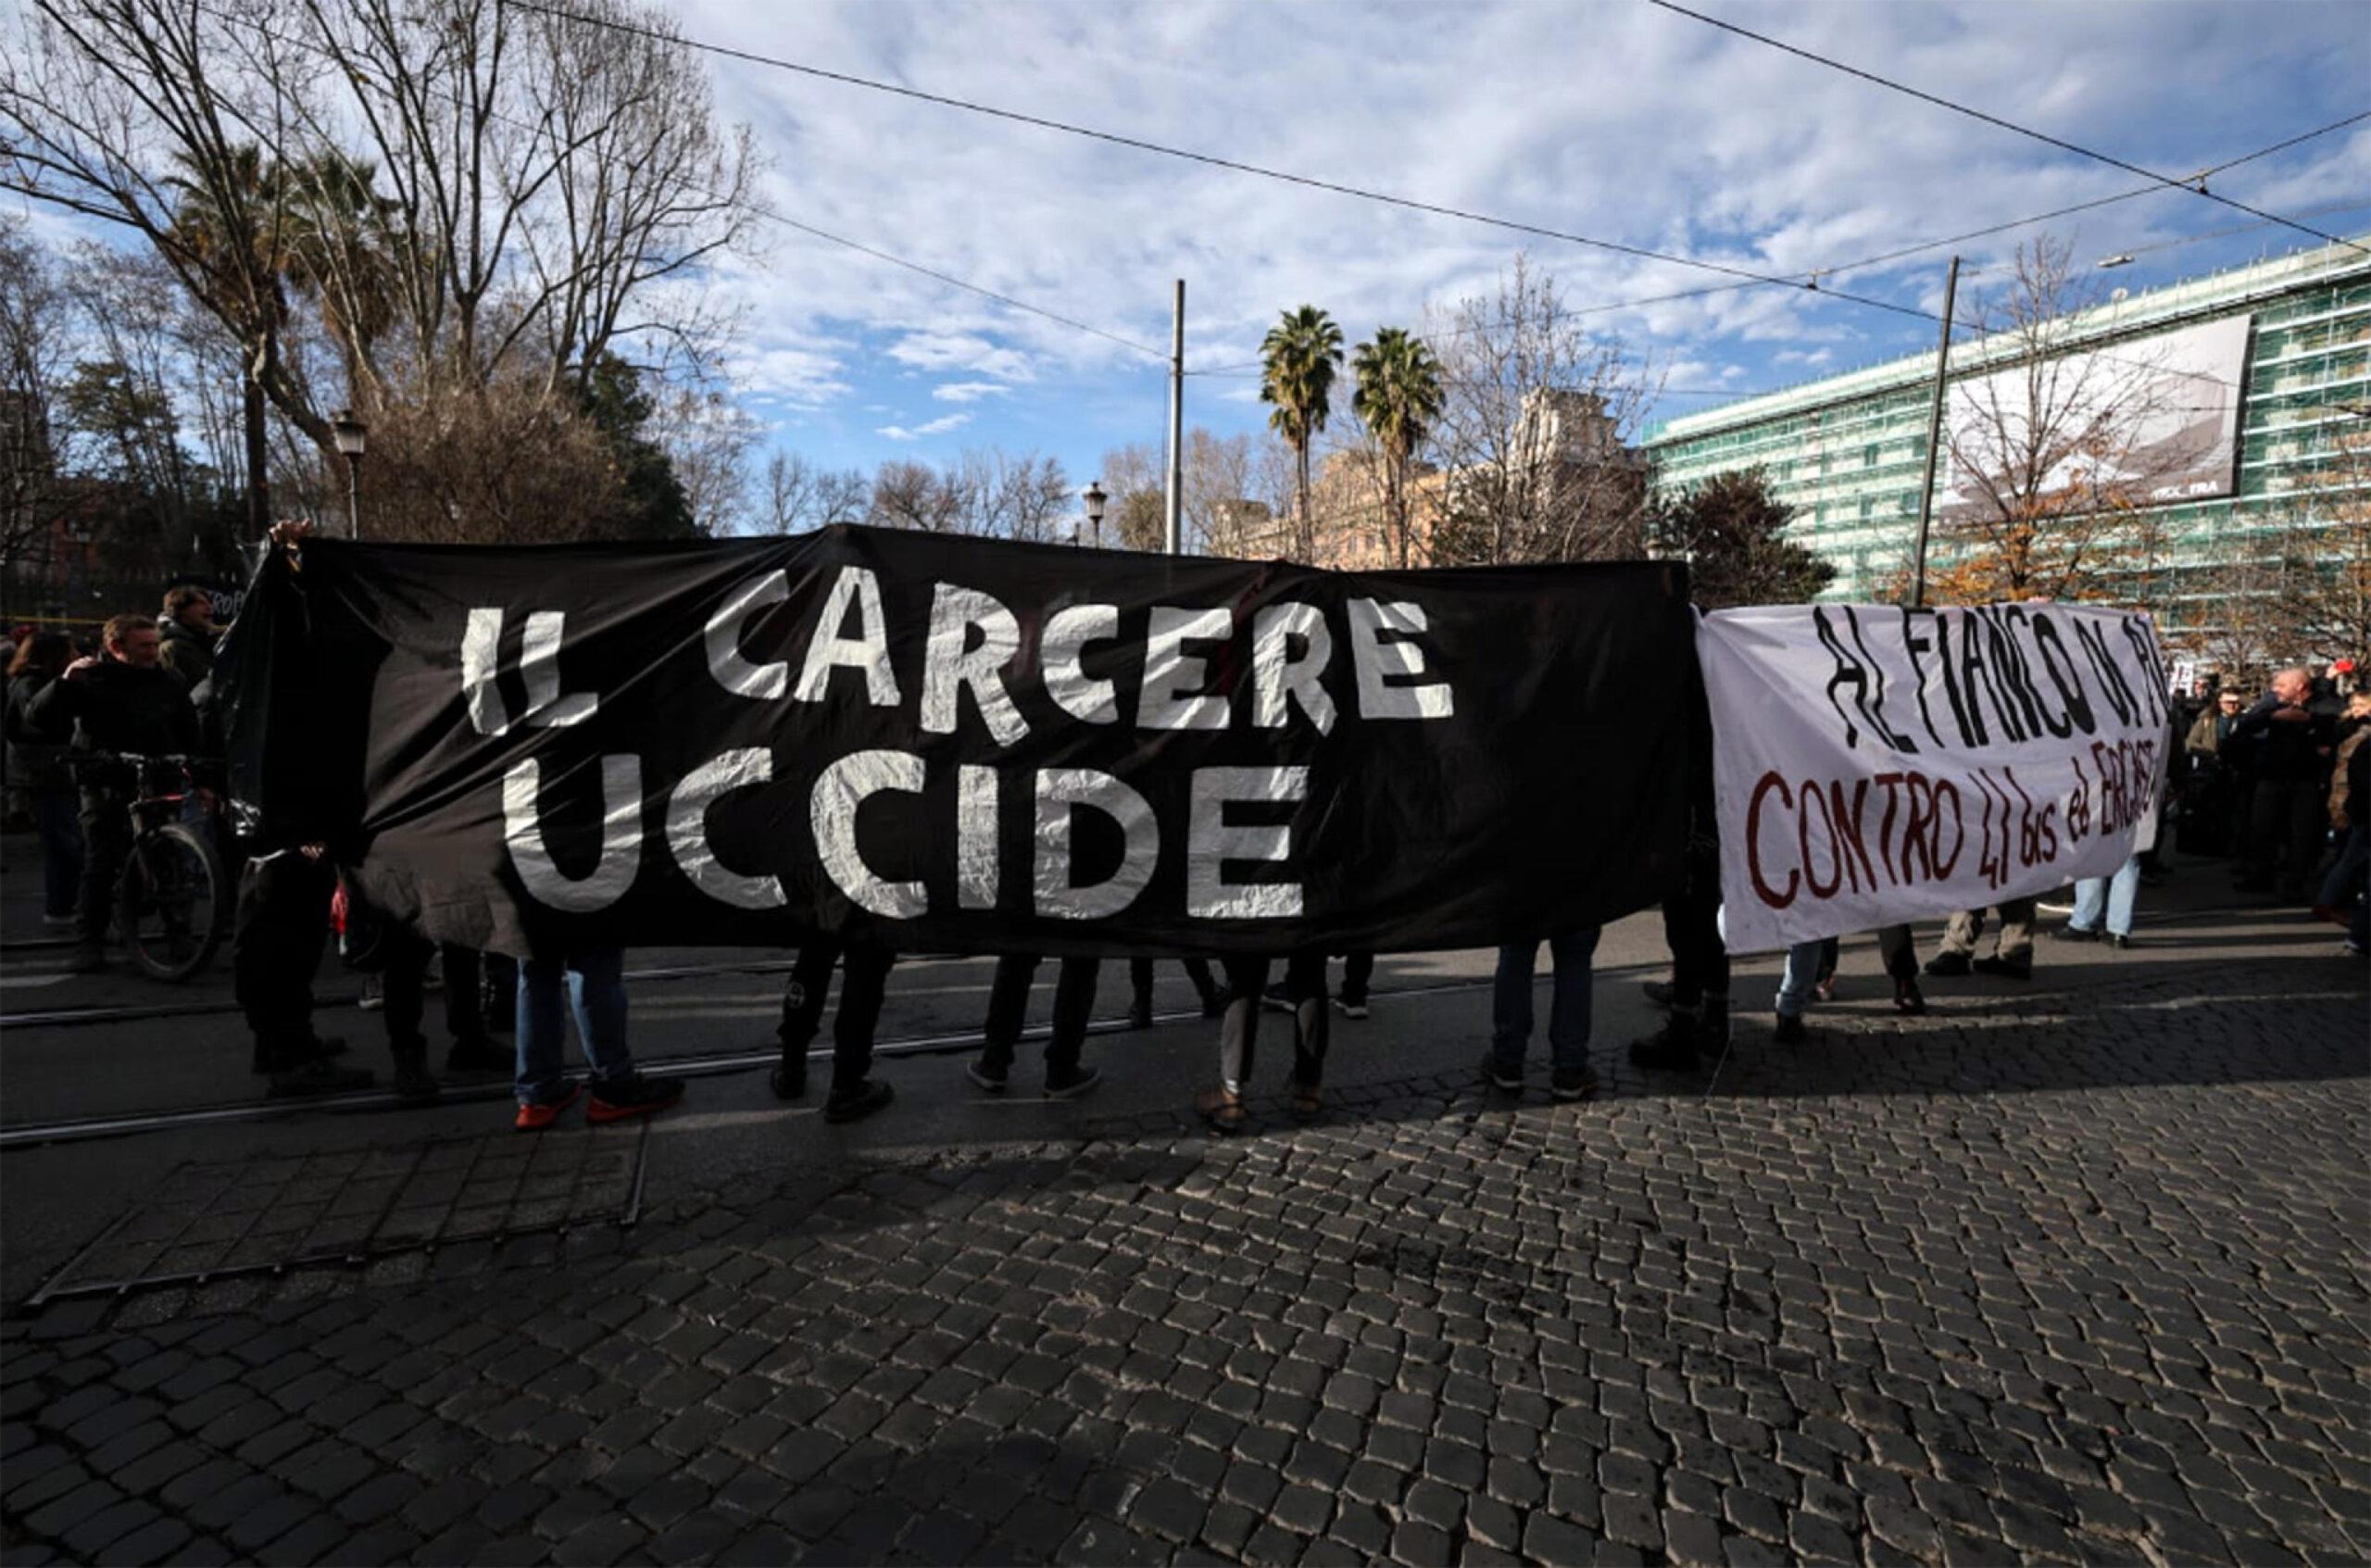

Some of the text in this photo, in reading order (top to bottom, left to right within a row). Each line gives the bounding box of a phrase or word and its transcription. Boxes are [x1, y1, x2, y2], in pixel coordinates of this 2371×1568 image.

[461, 564, 1454, 747] IL CARCERE
[1813, 605, 1919, 754] AL
[1901, 604, 2096, 748] FIANCO
[502, 746, 1311, 921] UCCIDE
[1747, 770, 1963, 910] CONTRO
[1966, 765, 2012, 891] 41
[2003, 765, 2059, 869] bis
[2067, 755, 2090, 843] ed
